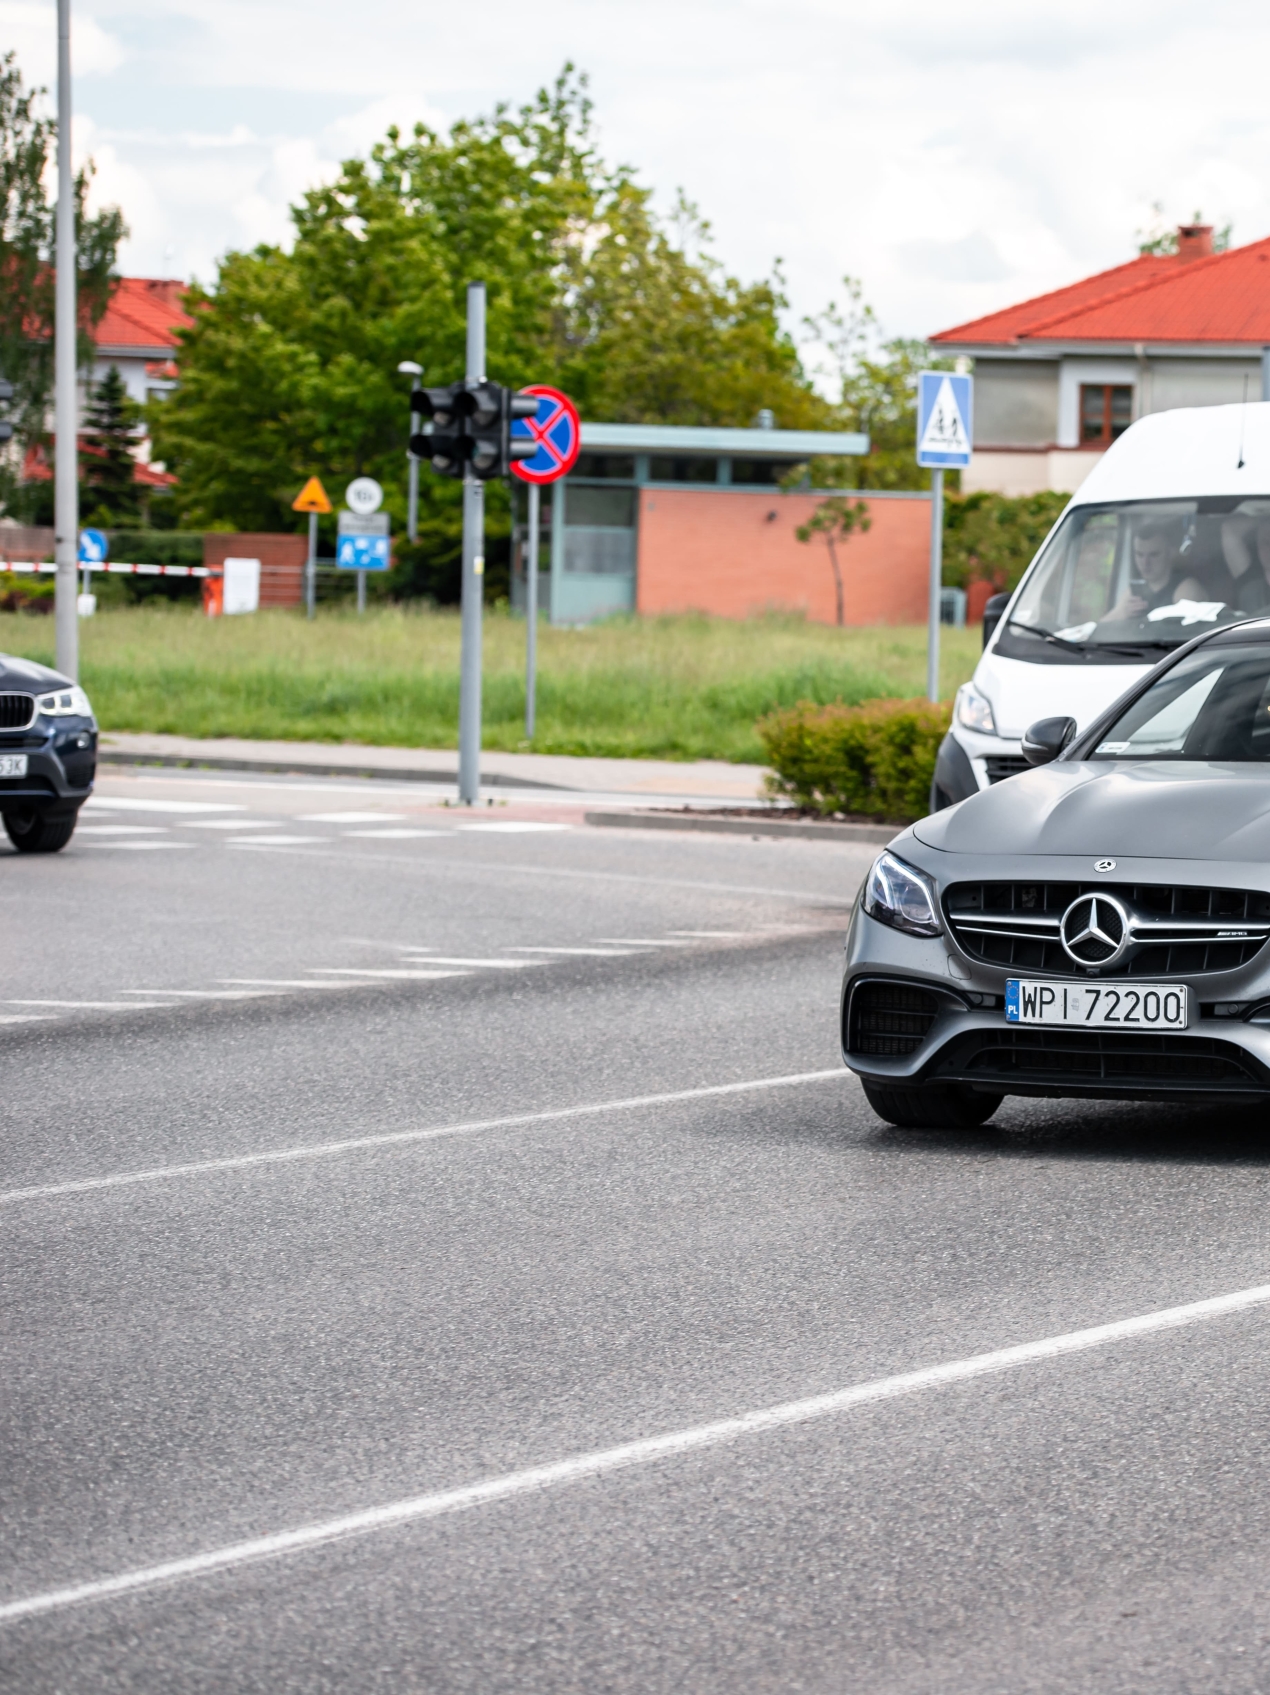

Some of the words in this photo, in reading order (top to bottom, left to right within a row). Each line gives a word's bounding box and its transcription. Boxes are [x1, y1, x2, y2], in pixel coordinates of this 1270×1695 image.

[1008, 1005, 1018, 1015] PL
[1022, 985, 1068, 1020] WPI
[1084, 988, 1181, 1023] 72200
